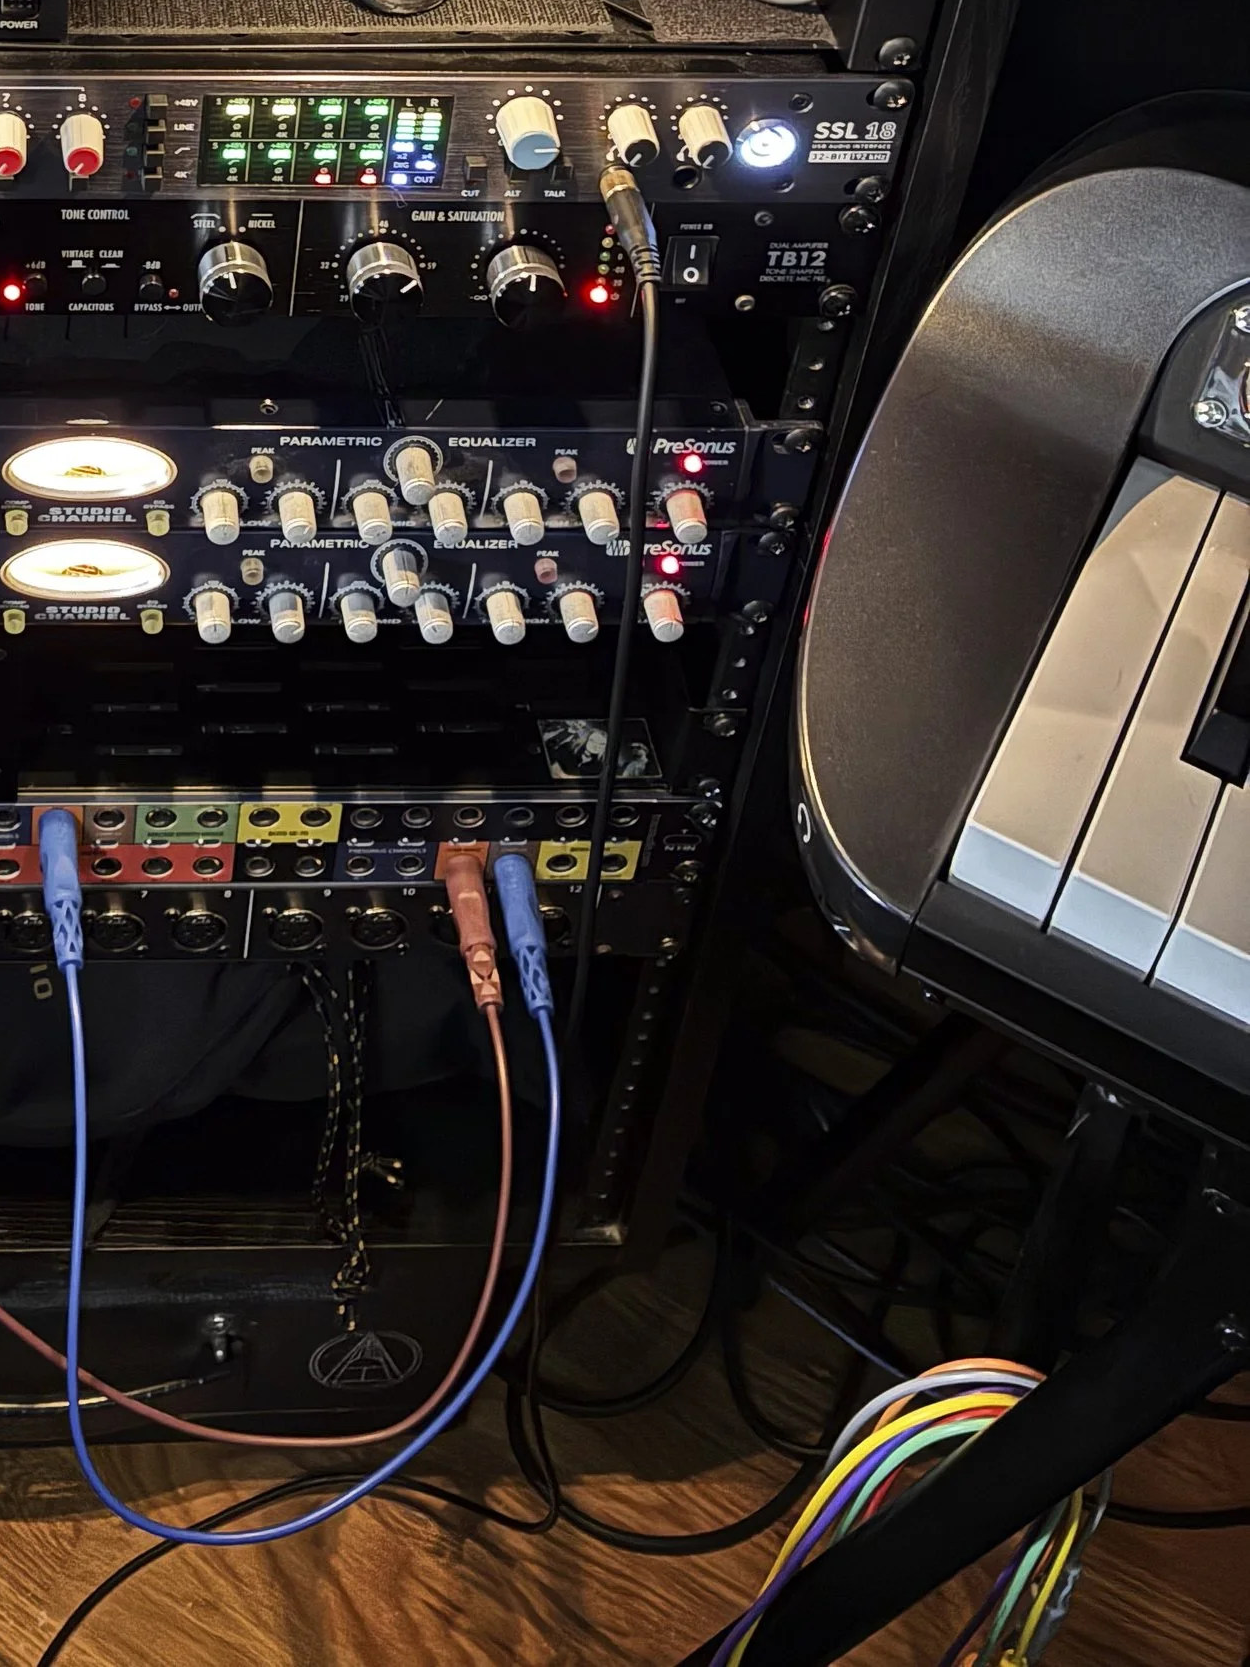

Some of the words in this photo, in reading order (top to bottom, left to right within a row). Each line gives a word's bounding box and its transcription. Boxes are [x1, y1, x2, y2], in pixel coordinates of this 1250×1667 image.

[0, 21, 38, 29] POWER
[175, 99, 199, 107] +48V
[405, 98, 414, 107] L
[430, 98, 439, 107] R
[174, 123, 195, 131] LINE
[814, 122, 858, 140] SSL
[865, 122, 897, 140] 18
[61, 210, 85, 220] TONE
[87, 210, 130, 221] CONTROL
[412, 210, 437, 221] GAIN
[448, 211, 504, 223] SATURATION
[193, 220, 216, 229] STEEL
[248, 220, 276, 229] NICKEL
[61, 250, 94, 259] VINTAGE
[99, 250, 123, 259] CLEAN
[767, 251, 827, 266] TB12
[25, 303, 45, 312] TONE
[69, 303, 114, 312] CAPACITORS
[134, 304, 163, 312] BYPASS
[280, 436, 383, 447] PARAMETRIC
[448, 436, 536, 448] EQUALIZER
[652, 438, 736, 454] PreSonus
[251, 447, 274, 456] PEAK
[554, 448, 578, 456] PEAK
[49, 506, 126, 515] STUDIO
[38, 513, 137, 523] CHANNEL
[644, 540, 712, 556] reSonus
[243, 549, 266, 558] PEAK
[536, 550, 559, 558] PEAK
[45, 606, 120, 615] STUDIO
[35, 613, 131, 621] CHANNEL
[402, 888, 416, 896] 10
[569, 885, 582, 893] 12
